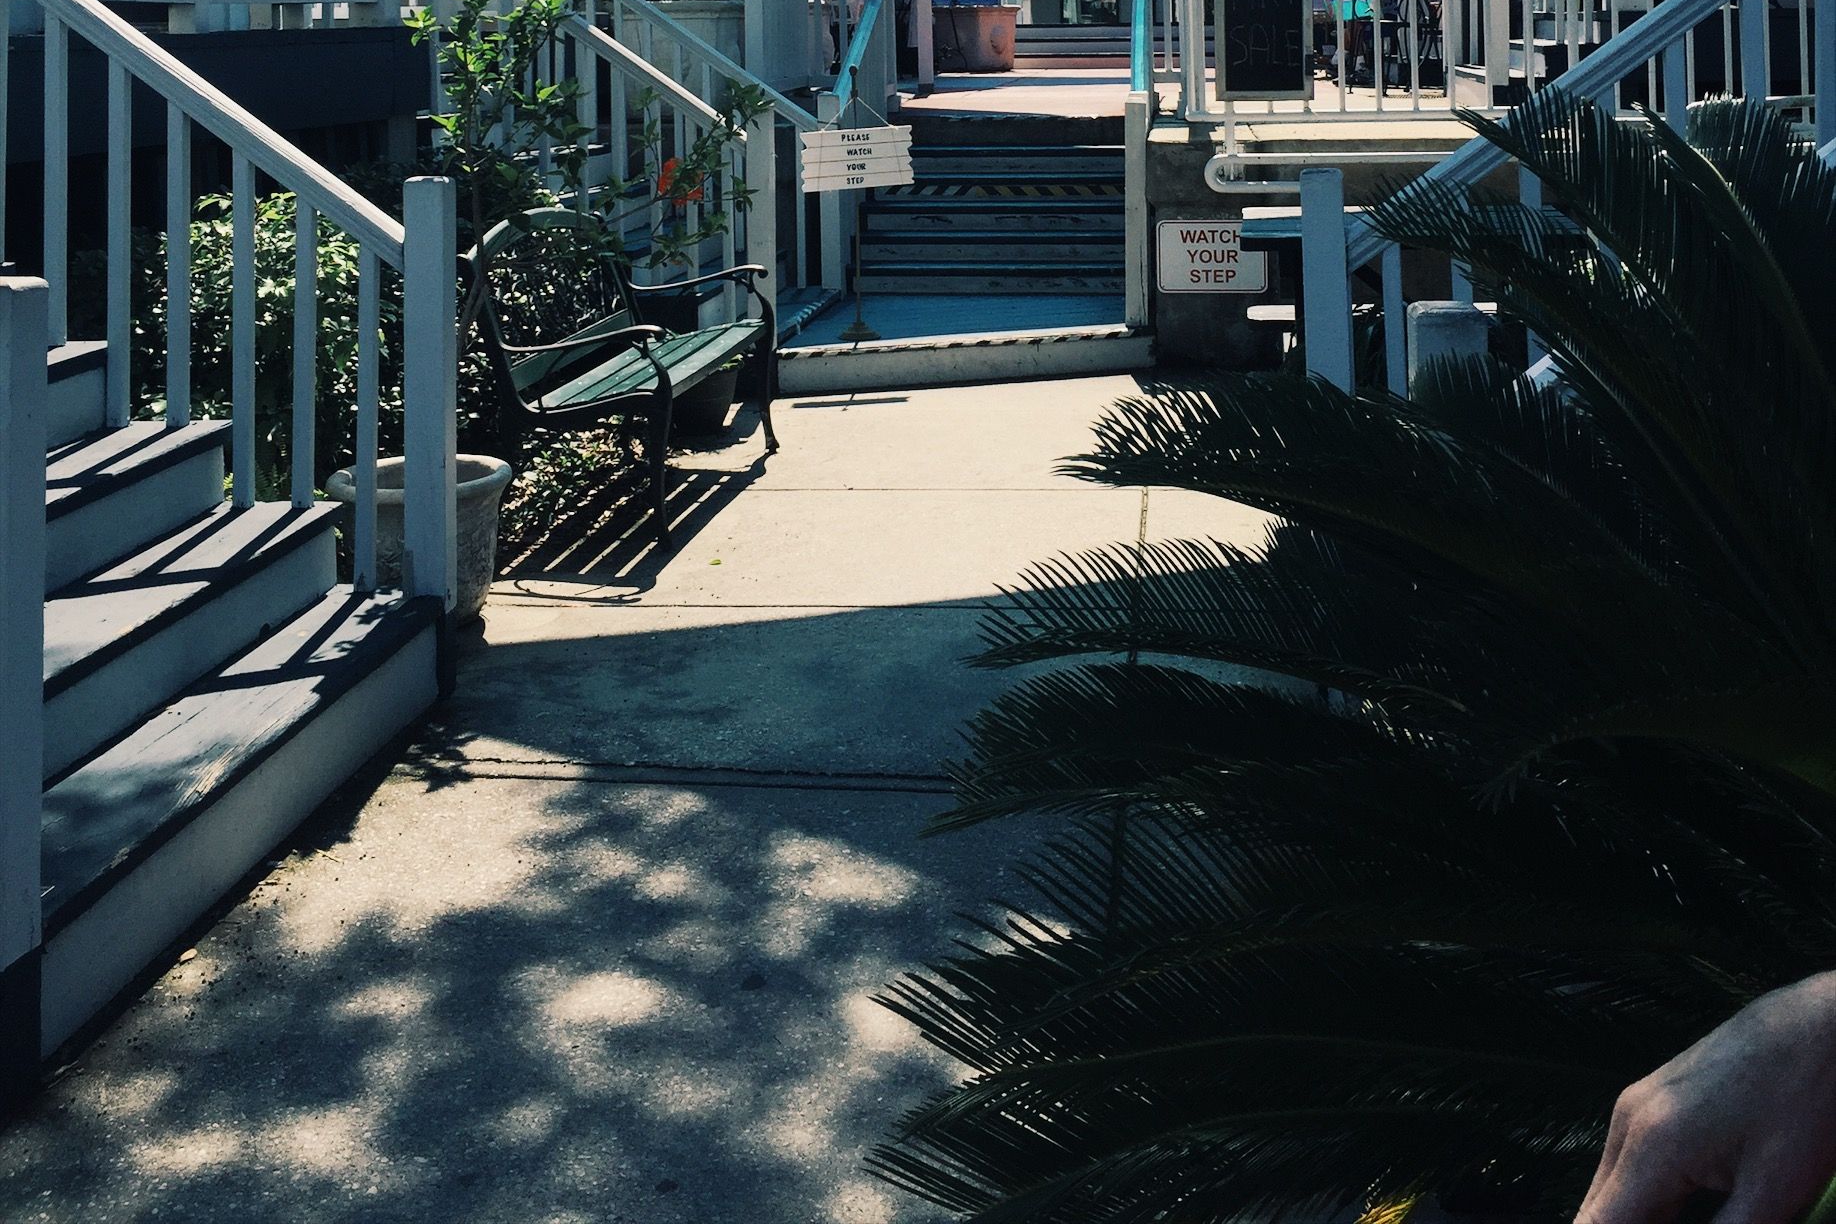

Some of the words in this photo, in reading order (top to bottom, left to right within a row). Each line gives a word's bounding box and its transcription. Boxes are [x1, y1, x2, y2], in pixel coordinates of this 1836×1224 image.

[1229, 23, 1302, 67] SALE
[841, 133, 870, 143] PLEASE
[846, 147, 873, 157] WATCH
[846, 162, 867, 172] YOUR
[846, 176, 865, 186] STEP
[1186, 249, 1239, 264] YOUR
[1190, 268, 1237, 284] STEP
